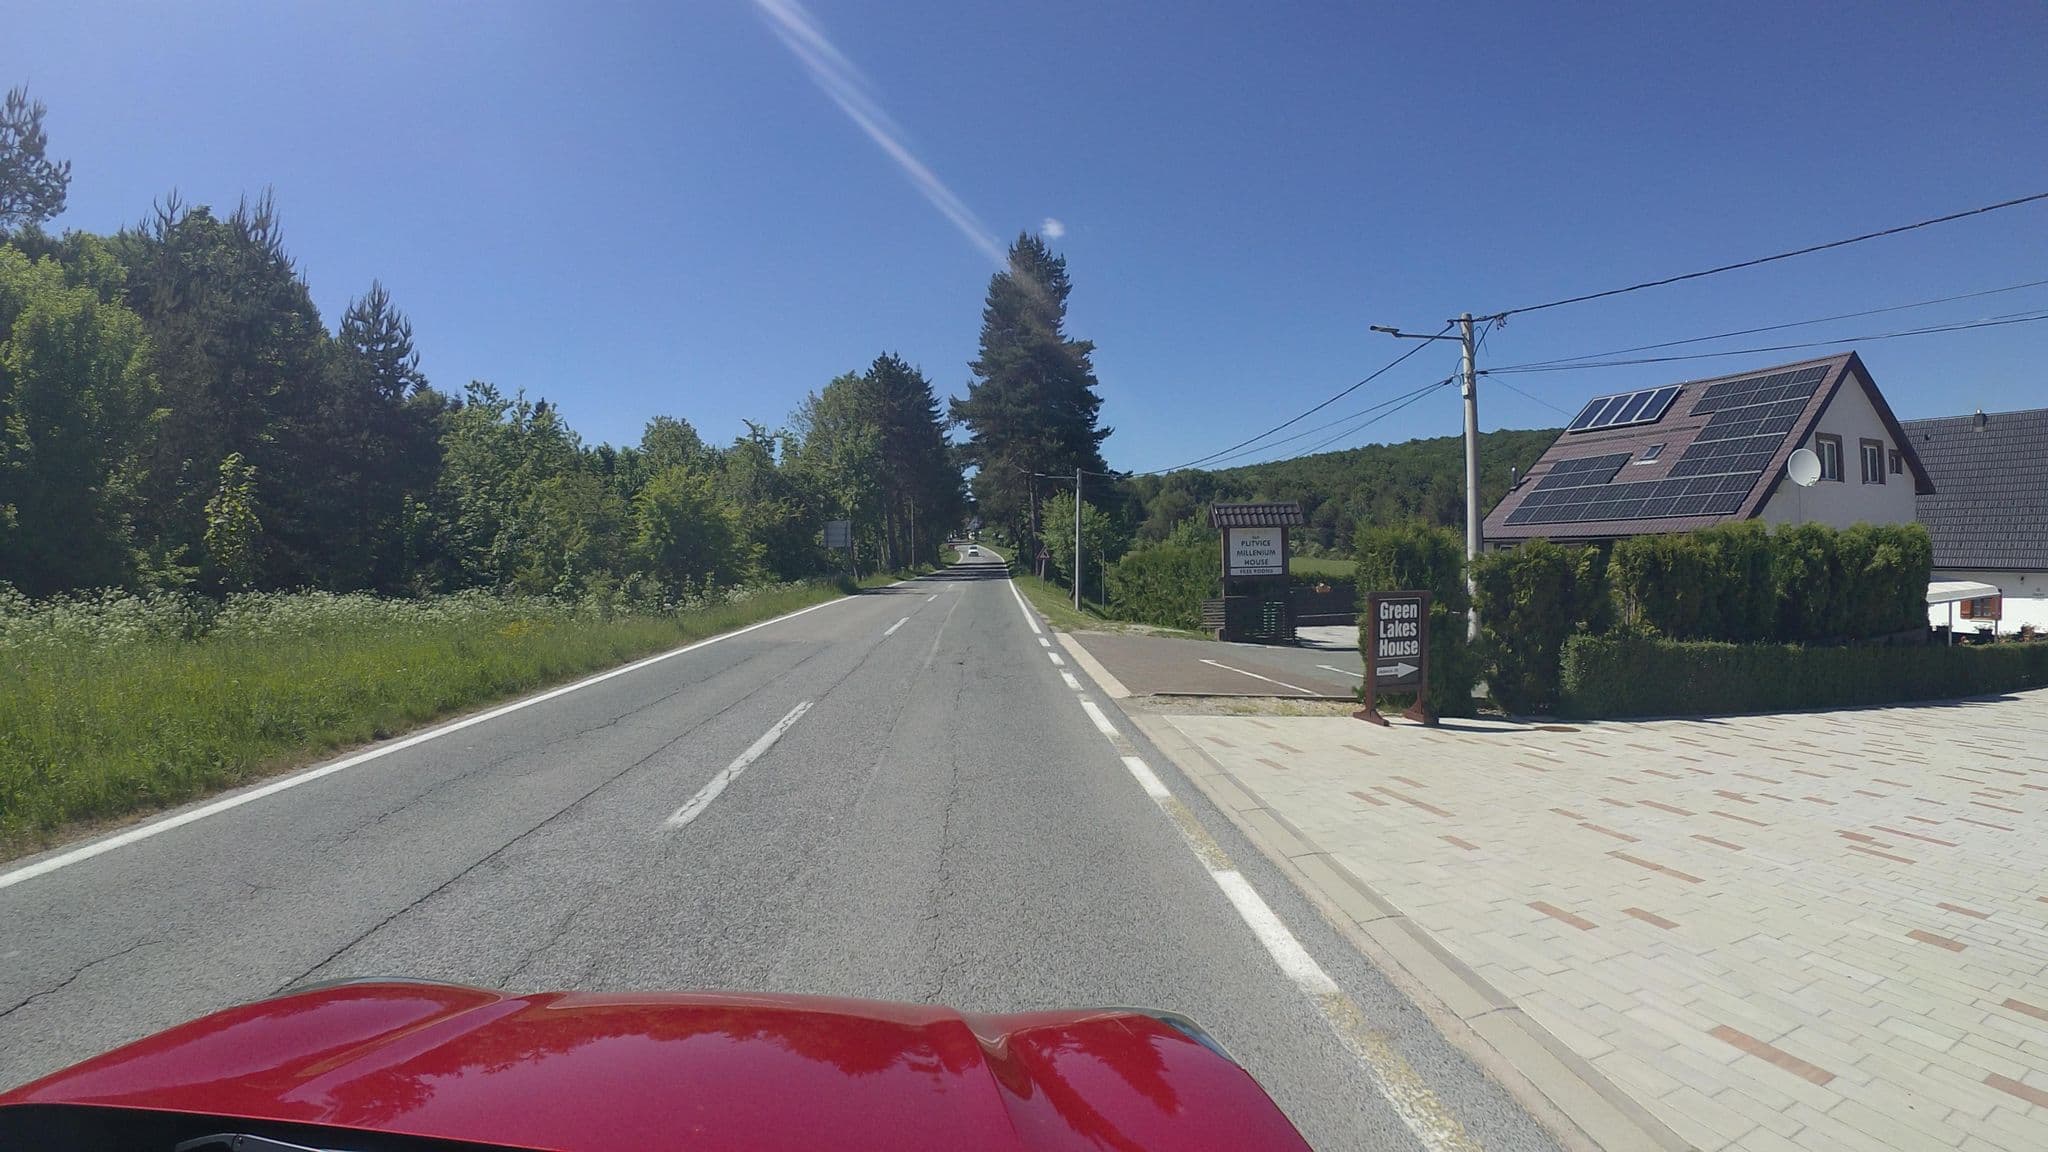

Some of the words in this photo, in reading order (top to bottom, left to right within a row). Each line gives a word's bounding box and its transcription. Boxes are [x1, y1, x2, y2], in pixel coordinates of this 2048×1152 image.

[1380, 602, 1417, 619] Green
[1380, 620, 1417, 638] Lakes
[1379, 639, 1418, 656] House
